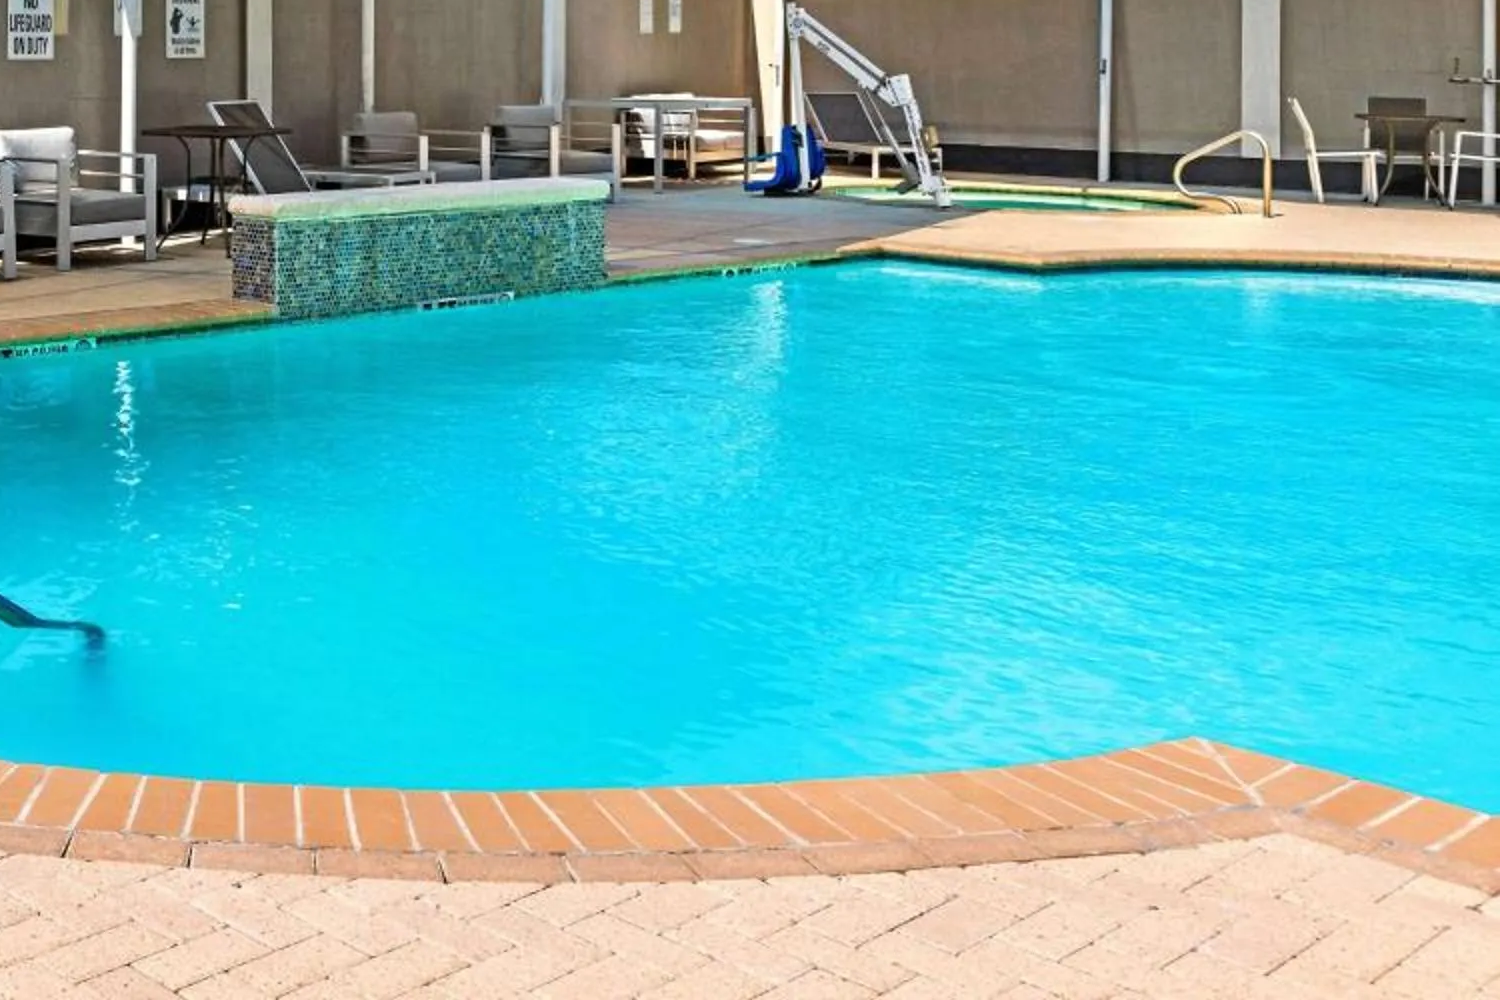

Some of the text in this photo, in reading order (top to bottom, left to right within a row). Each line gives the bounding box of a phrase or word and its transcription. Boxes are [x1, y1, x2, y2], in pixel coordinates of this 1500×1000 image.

[10, 13, 52, 32] LIFEGUARD
[13, 37, 49, 55] ON DUTY
